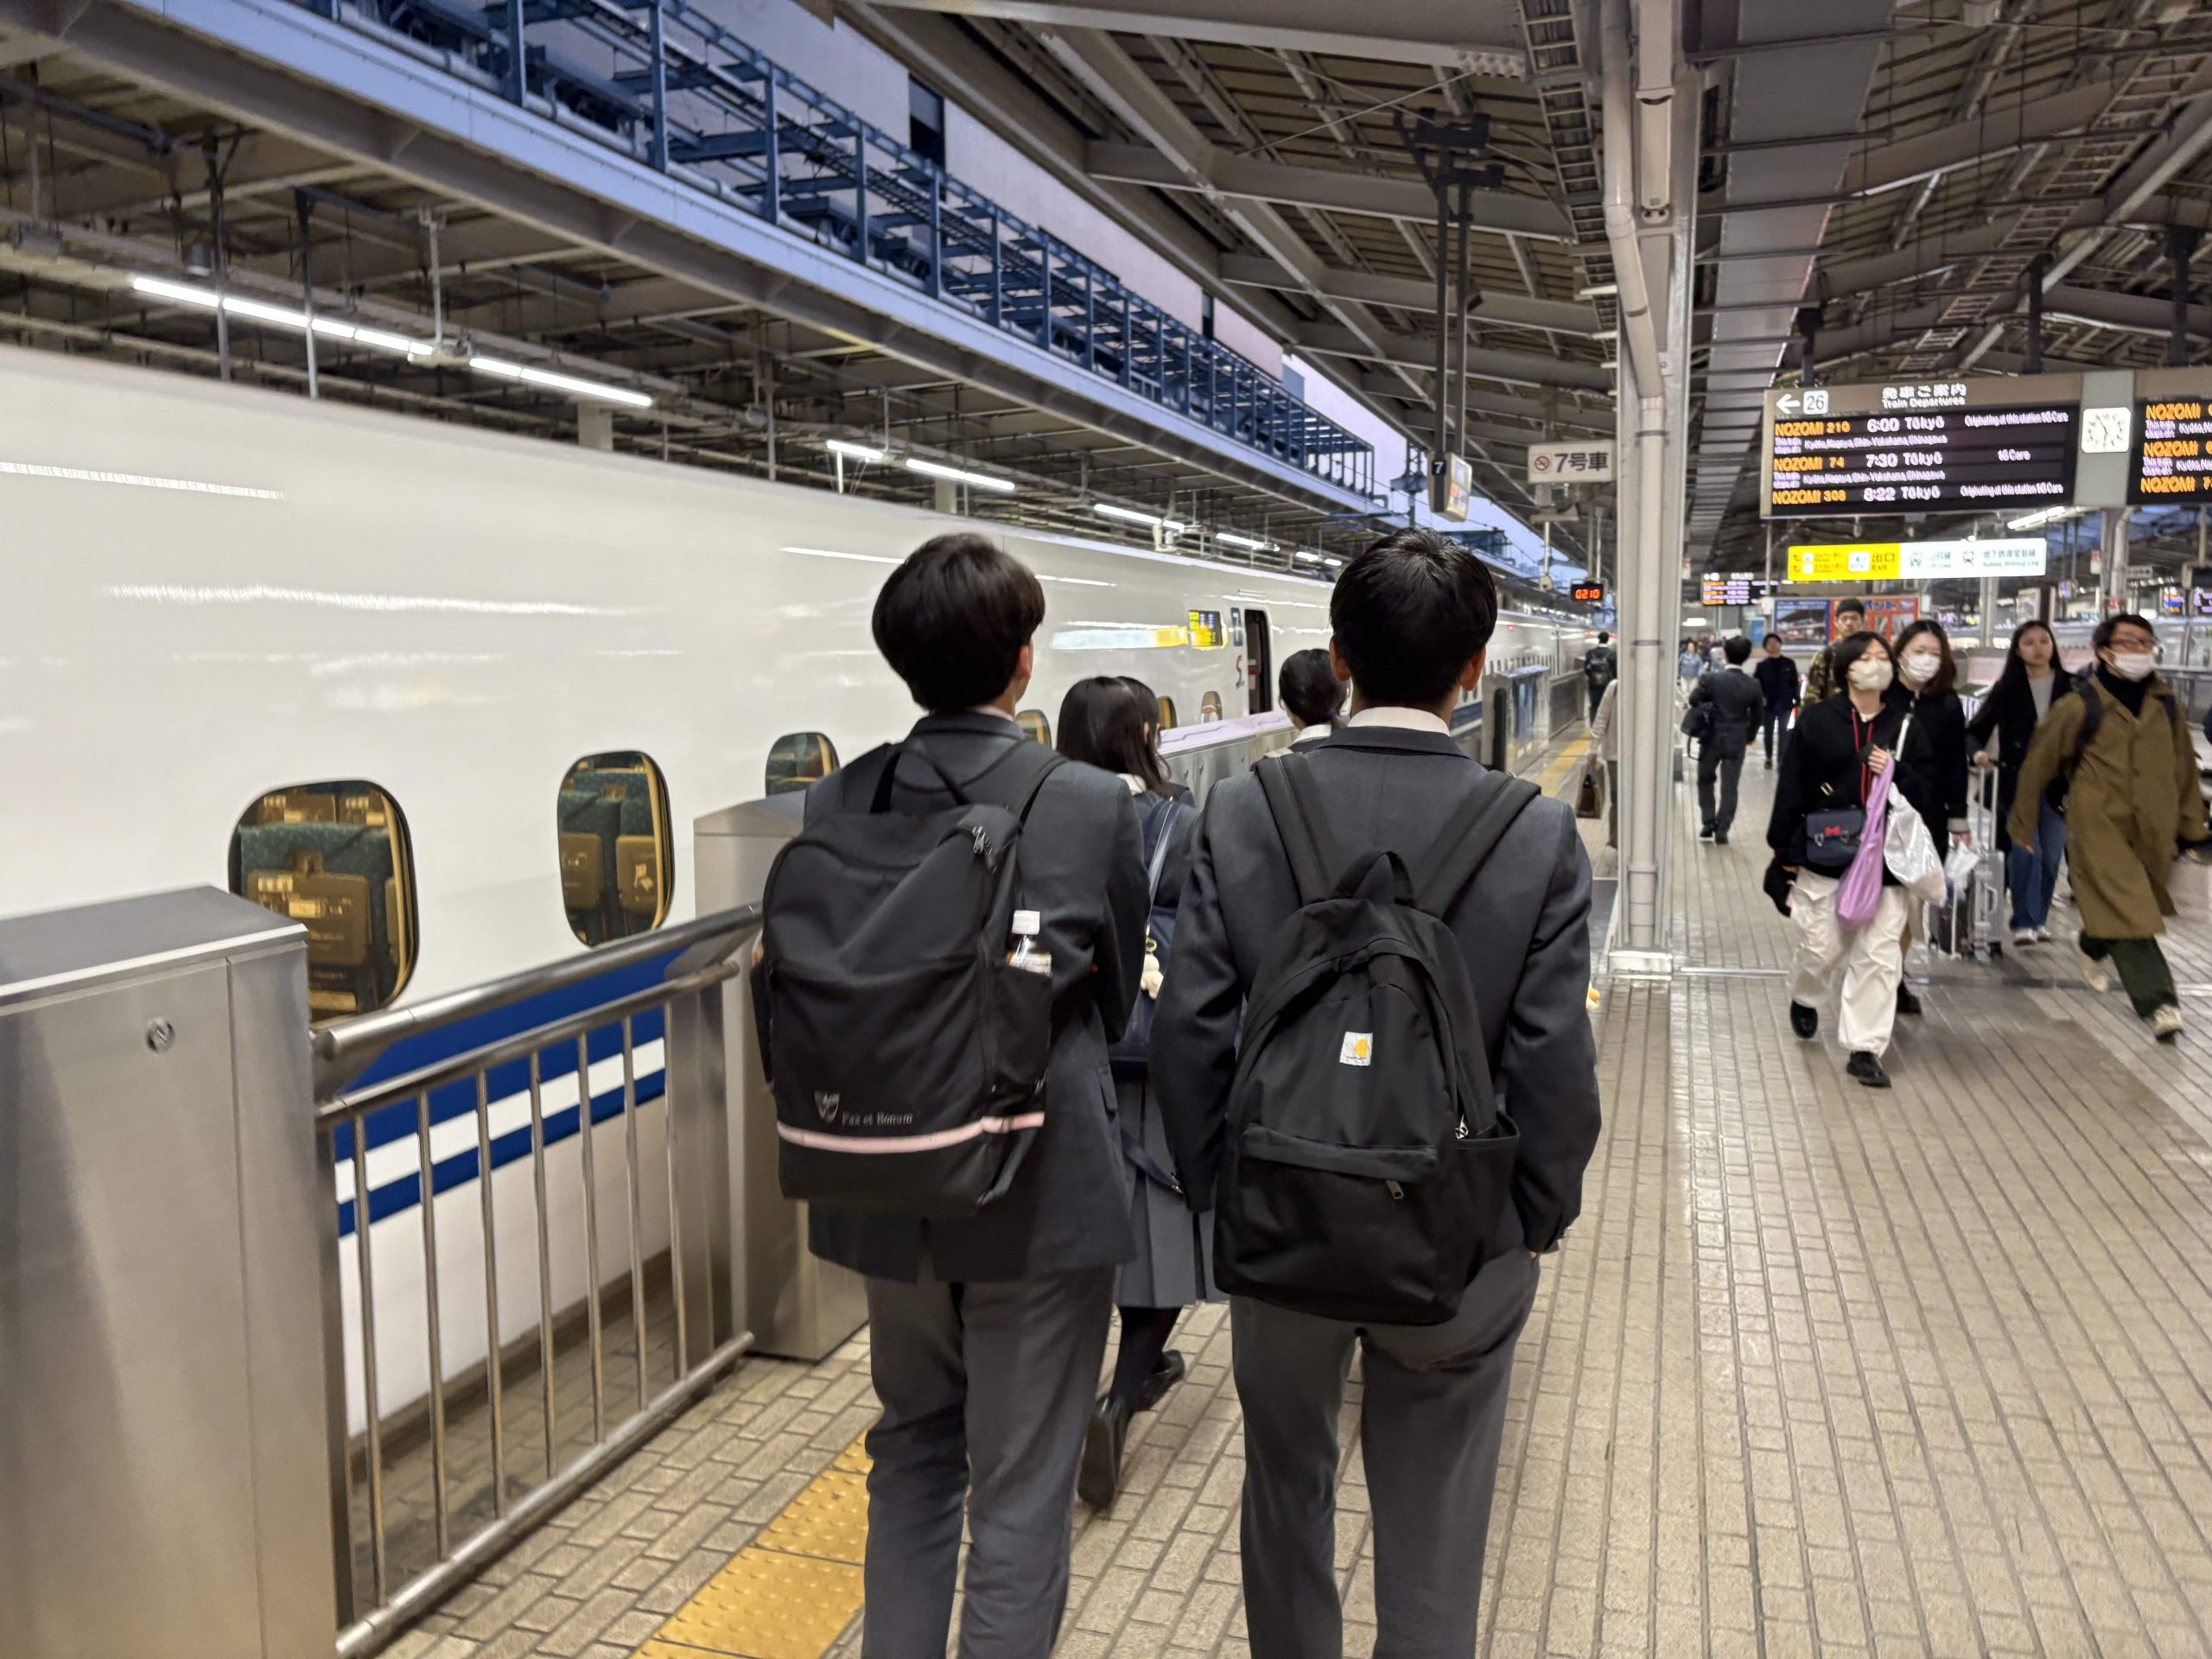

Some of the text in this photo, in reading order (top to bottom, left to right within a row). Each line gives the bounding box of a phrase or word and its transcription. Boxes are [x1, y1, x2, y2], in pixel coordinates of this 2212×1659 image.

[1807, 395, 1824, 410] 26
[1882, 398, 1908, 409] Train
[2145, 403, 2201, 420] NOZOMI
[1775, 421, 1824, 436] NOZOMI
[1867, 418, 1899, 432] 6:00
[2143, 441, 2199, 457] NOZOMI
[1434, 461, 1443, 474] 7
[1554, 452, 1608, 473] 7号車
[1774, 456, 1822, 472] NOZOMI
[1829, 456, 1844, 468] 74
[1866, 453, 1897, 467] 7:30
[2140, 476, 2196, 493] NOZOMI
[1772, 489, 1821, 505] NOZOMI
[1864, 486, 1896, 501] 8:22
[1872, 553, 1895, 563] 出口
